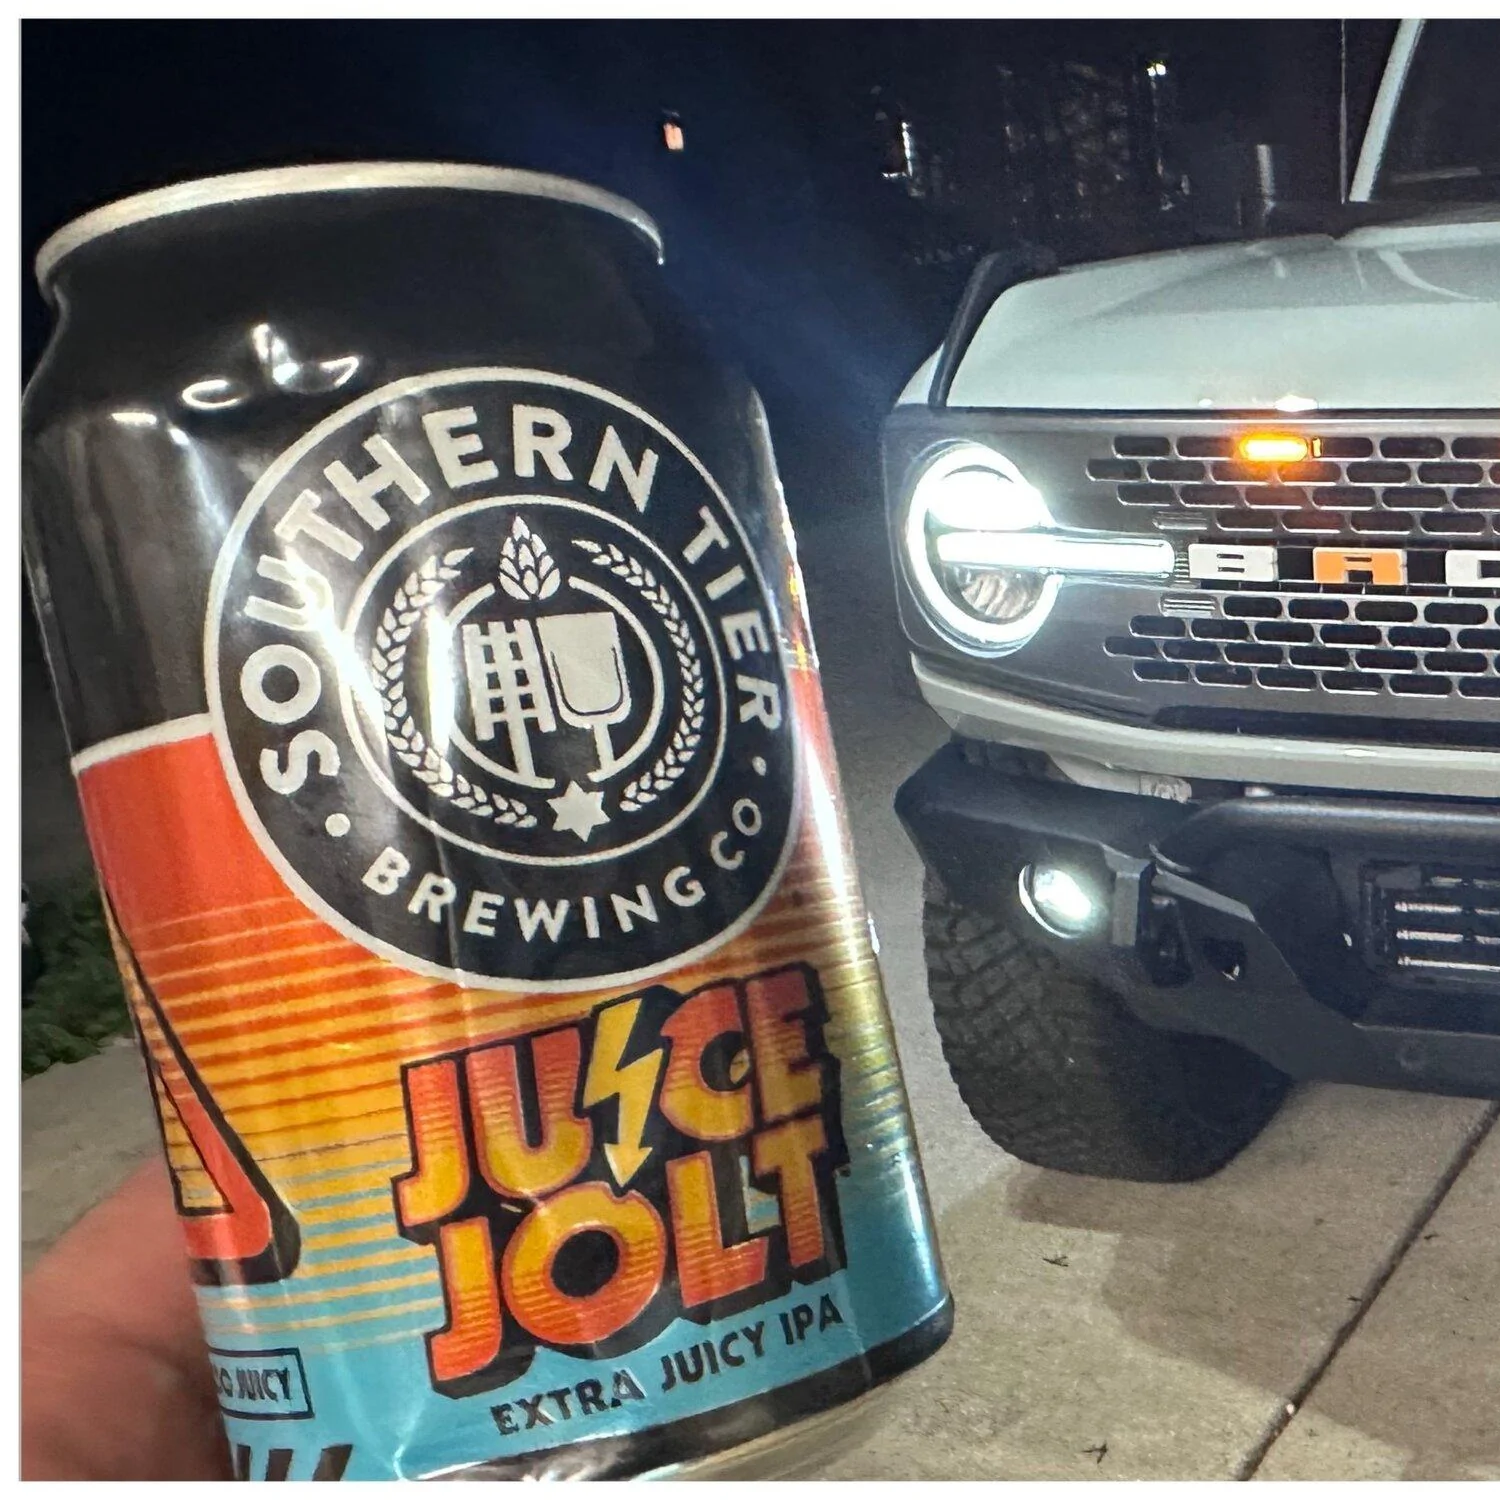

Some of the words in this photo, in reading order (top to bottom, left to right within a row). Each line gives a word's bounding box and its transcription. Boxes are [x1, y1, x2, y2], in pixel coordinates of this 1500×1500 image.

[239, 403, 659, 795] SOUTHERN
[682, 505, 783, 732] TIER
[361, 845, 706, 944] BREWING
[710, 796, 763, 870] CO
[393, 967, 828, 1228] JUICE
[430, 1111, 833, 1383] JOLT
[213, 1364, 234, 1399] O
[489, 1369, 649, 1436] EXTRA
[660, 1320, 765, 1393] JUICY
[778, 1292, 845, 1347] IPA
